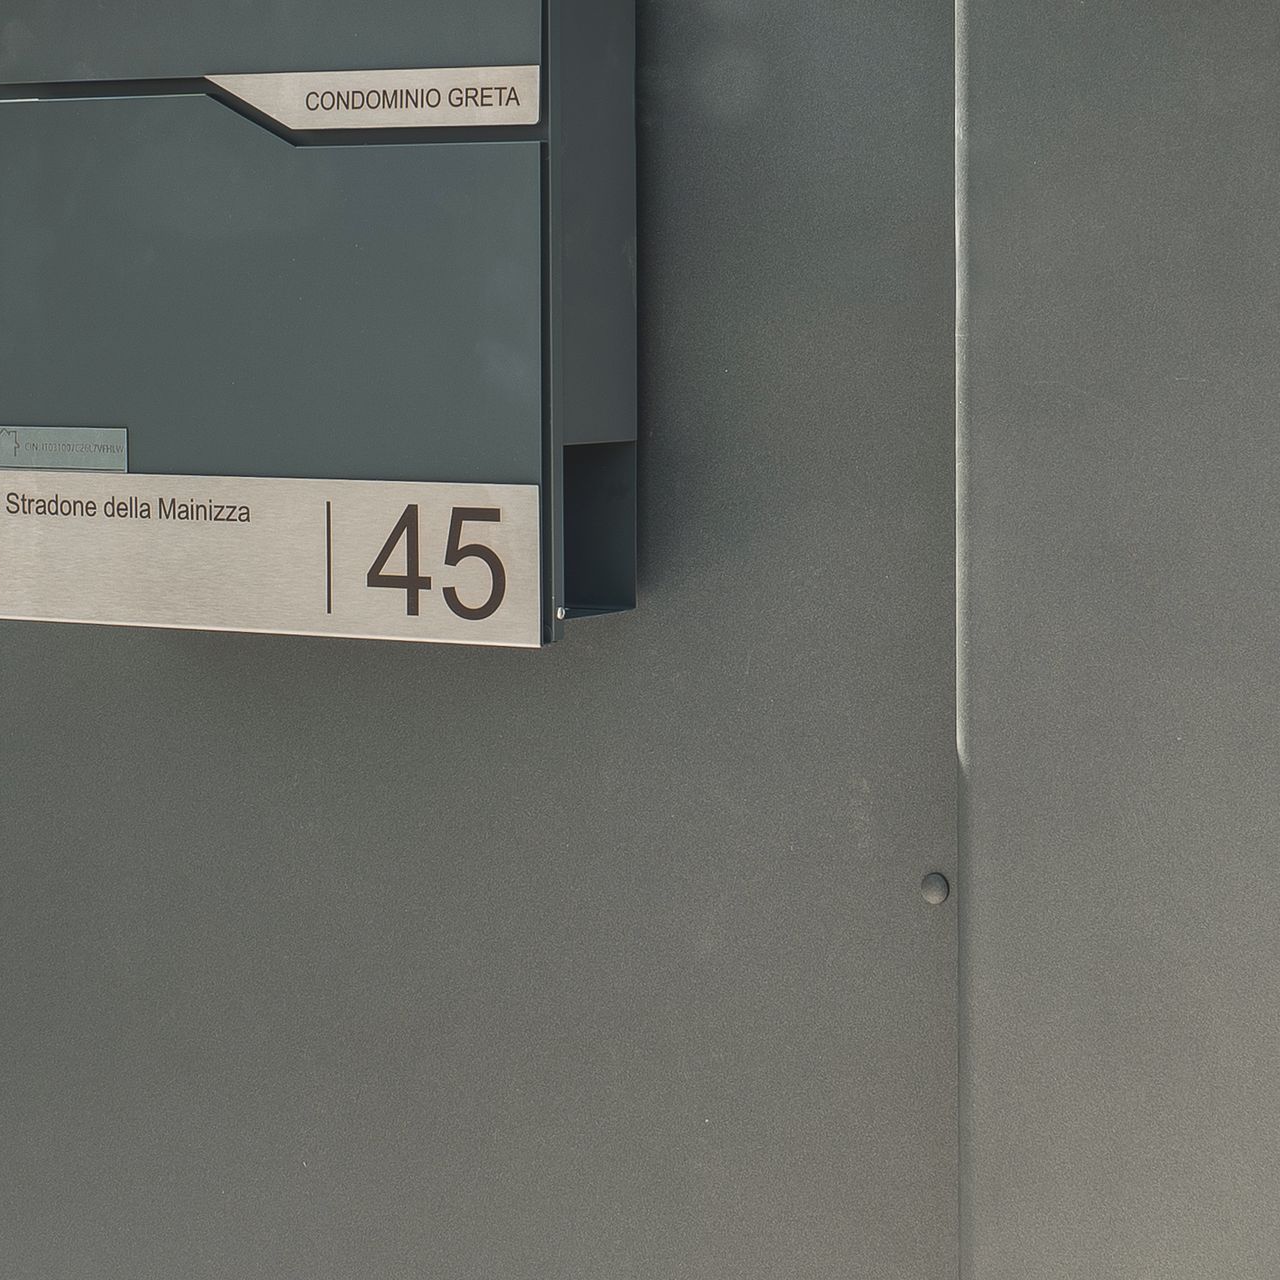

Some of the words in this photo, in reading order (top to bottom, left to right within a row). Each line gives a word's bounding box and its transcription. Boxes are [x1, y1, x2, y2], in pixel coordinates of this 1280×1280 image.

[306, 89, 441, 111] CONDOMINIO
[449, 87, 520, 107] GRETA
[6, 493, 96, 516] Stradone
[104, 496, 150, 519] della
[159, 498, 250, 522] Mainizza
[367, 504, 505, 620] 45
